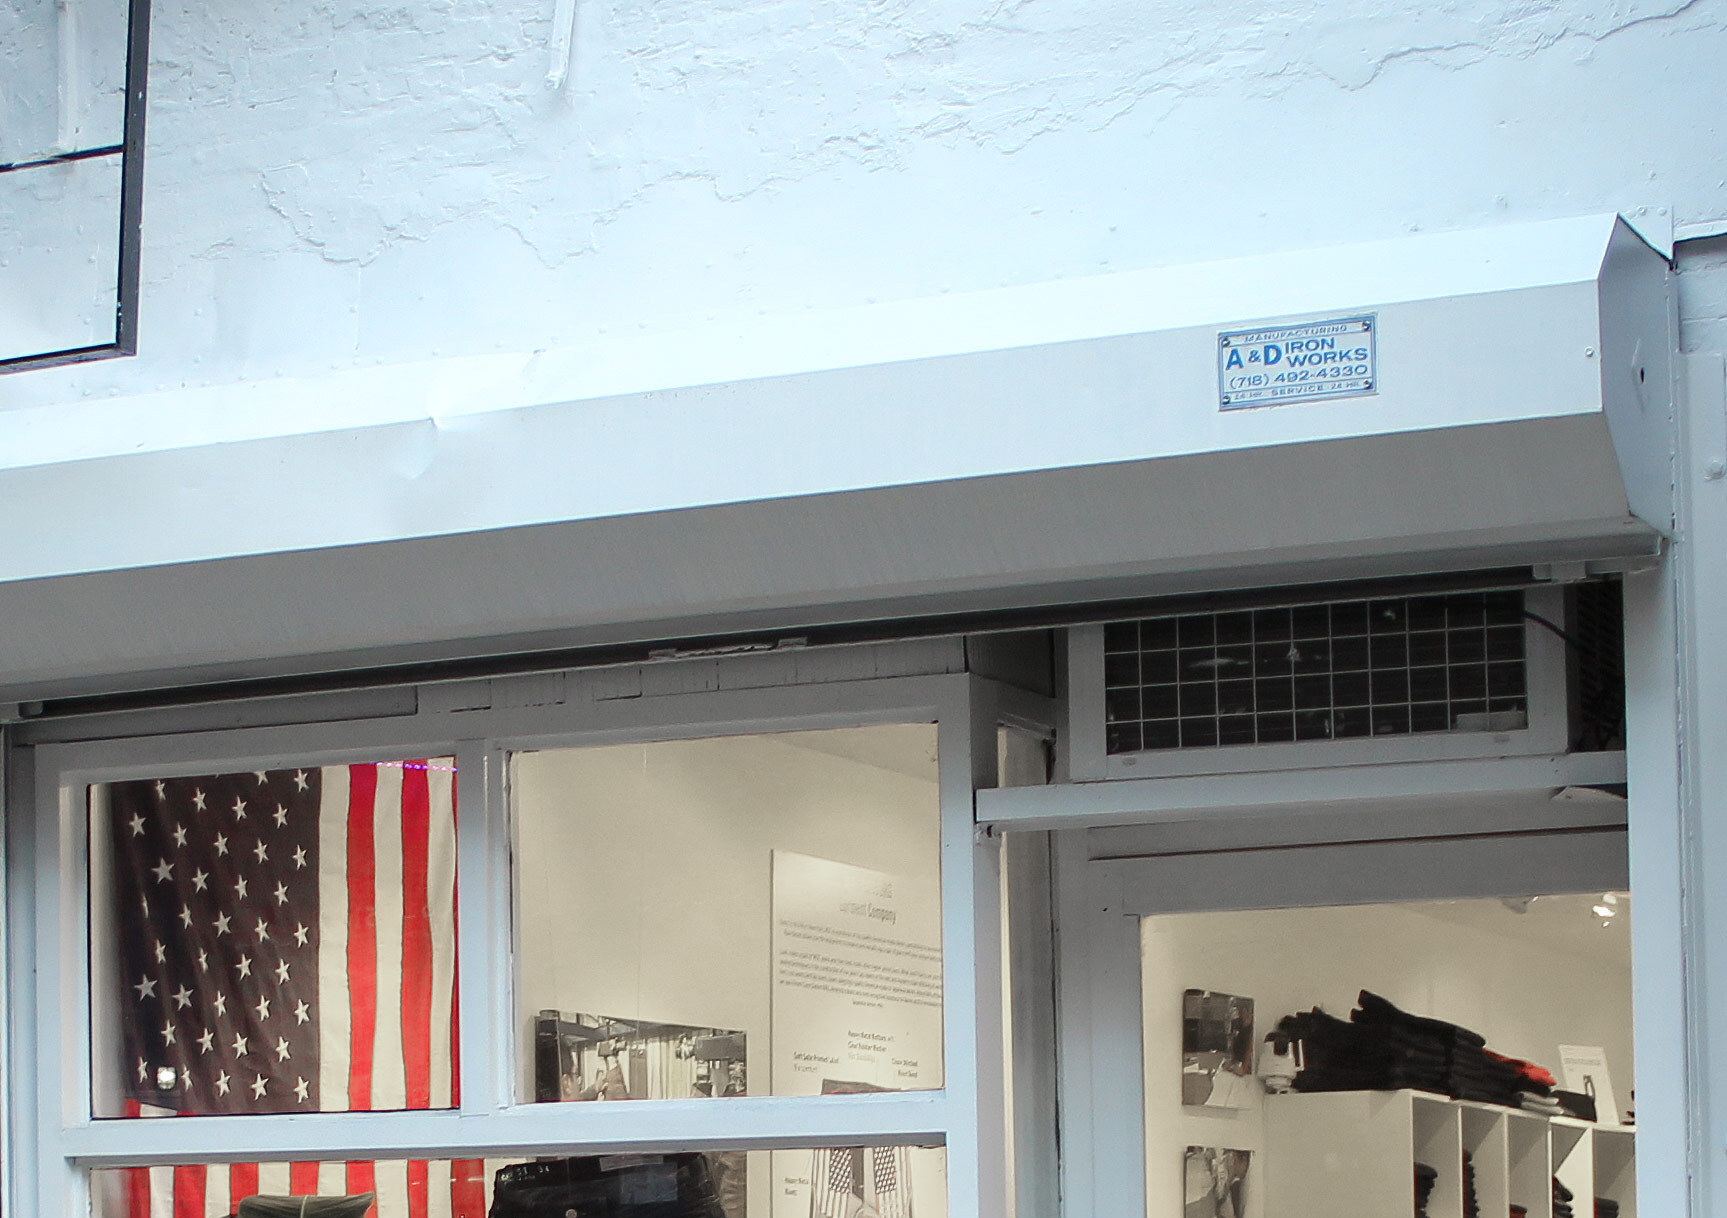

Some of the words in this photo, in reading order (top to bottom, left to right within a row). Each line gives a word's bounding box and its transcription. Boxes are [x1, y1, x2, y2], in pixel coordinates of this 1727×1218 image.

[1225, 348, 1244, 370] A
[1248, 350, 1262, 363] &
[1264, 343, 1282, 366] D
[1285, 337, 1335, 354] IRON
[1287, 347, 1368, 368] WORKS
[1230, 374, 1269, 390] (718)
